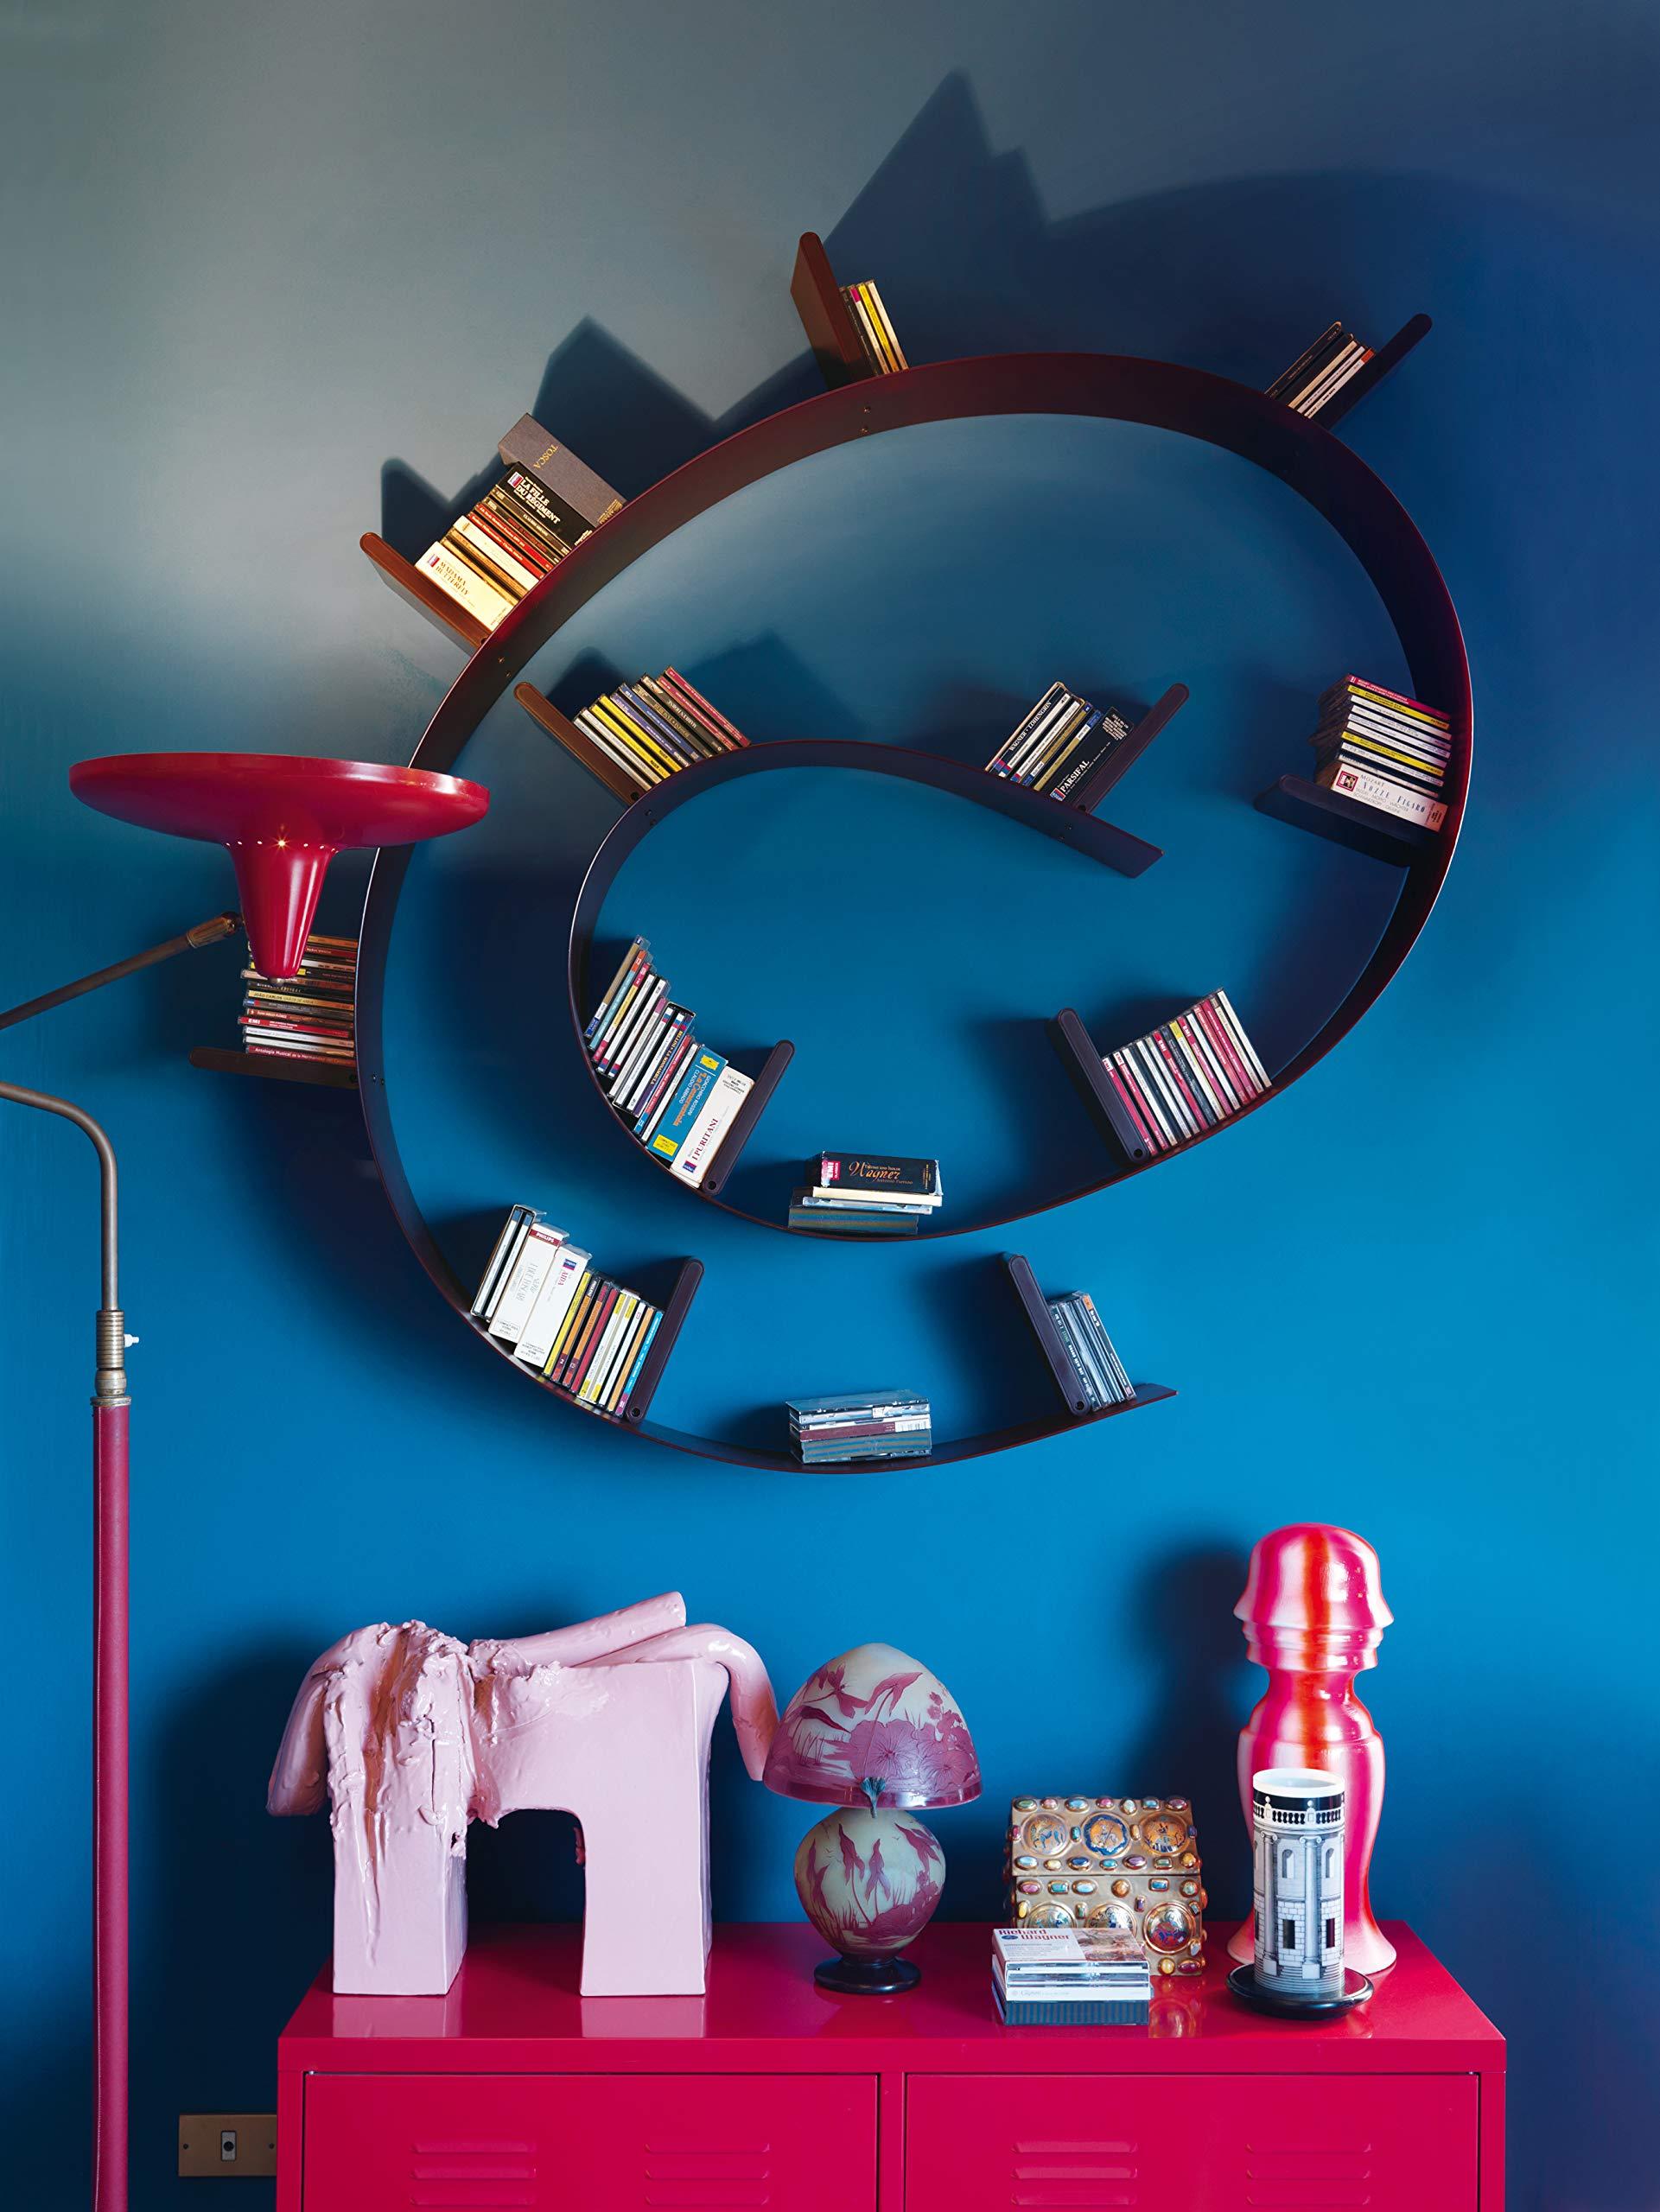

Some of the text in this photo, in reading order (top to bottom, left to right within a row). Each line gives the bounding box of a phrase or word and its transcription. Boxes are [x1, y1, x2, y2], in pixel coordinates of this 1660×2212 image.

[532, 442, 557, 470] TOSCA
[515, 484, 528, 496] DU
[519, 479, 550, 505] LA FILLE
[435, 565, 469, 595] BUTTERFLY
[439, 561, 467, 586] MADAMA
[679, 710, 697, 728] MARILYN
[1008, 700, 1053, 752] WAGNER LOHENGRIN
[1059, 758, 1090, 792] PARSIFAL
[1360, 774, 1383, 787] MOZART
[670, 1030, 683, 1048] BELLINI
[1181, 1024, 1192, 1037] EMI
[1157, 1039, 1167, 1052] EMI
[649, 1056, 668, 1085] SONNAMBULA
[677, 1068, 699, 1103] CLAUDIO ABBADO
[686, 1074, 711, 1116] GIOACCHINO ROSSINI
[693, 1117, 718, 1156] PURITANI
[848, 1160, 900, 1184] Wagner
[535, 1231, 555, 1243] PHILIPS
[557, 1269, 569, 1287] AIDA
